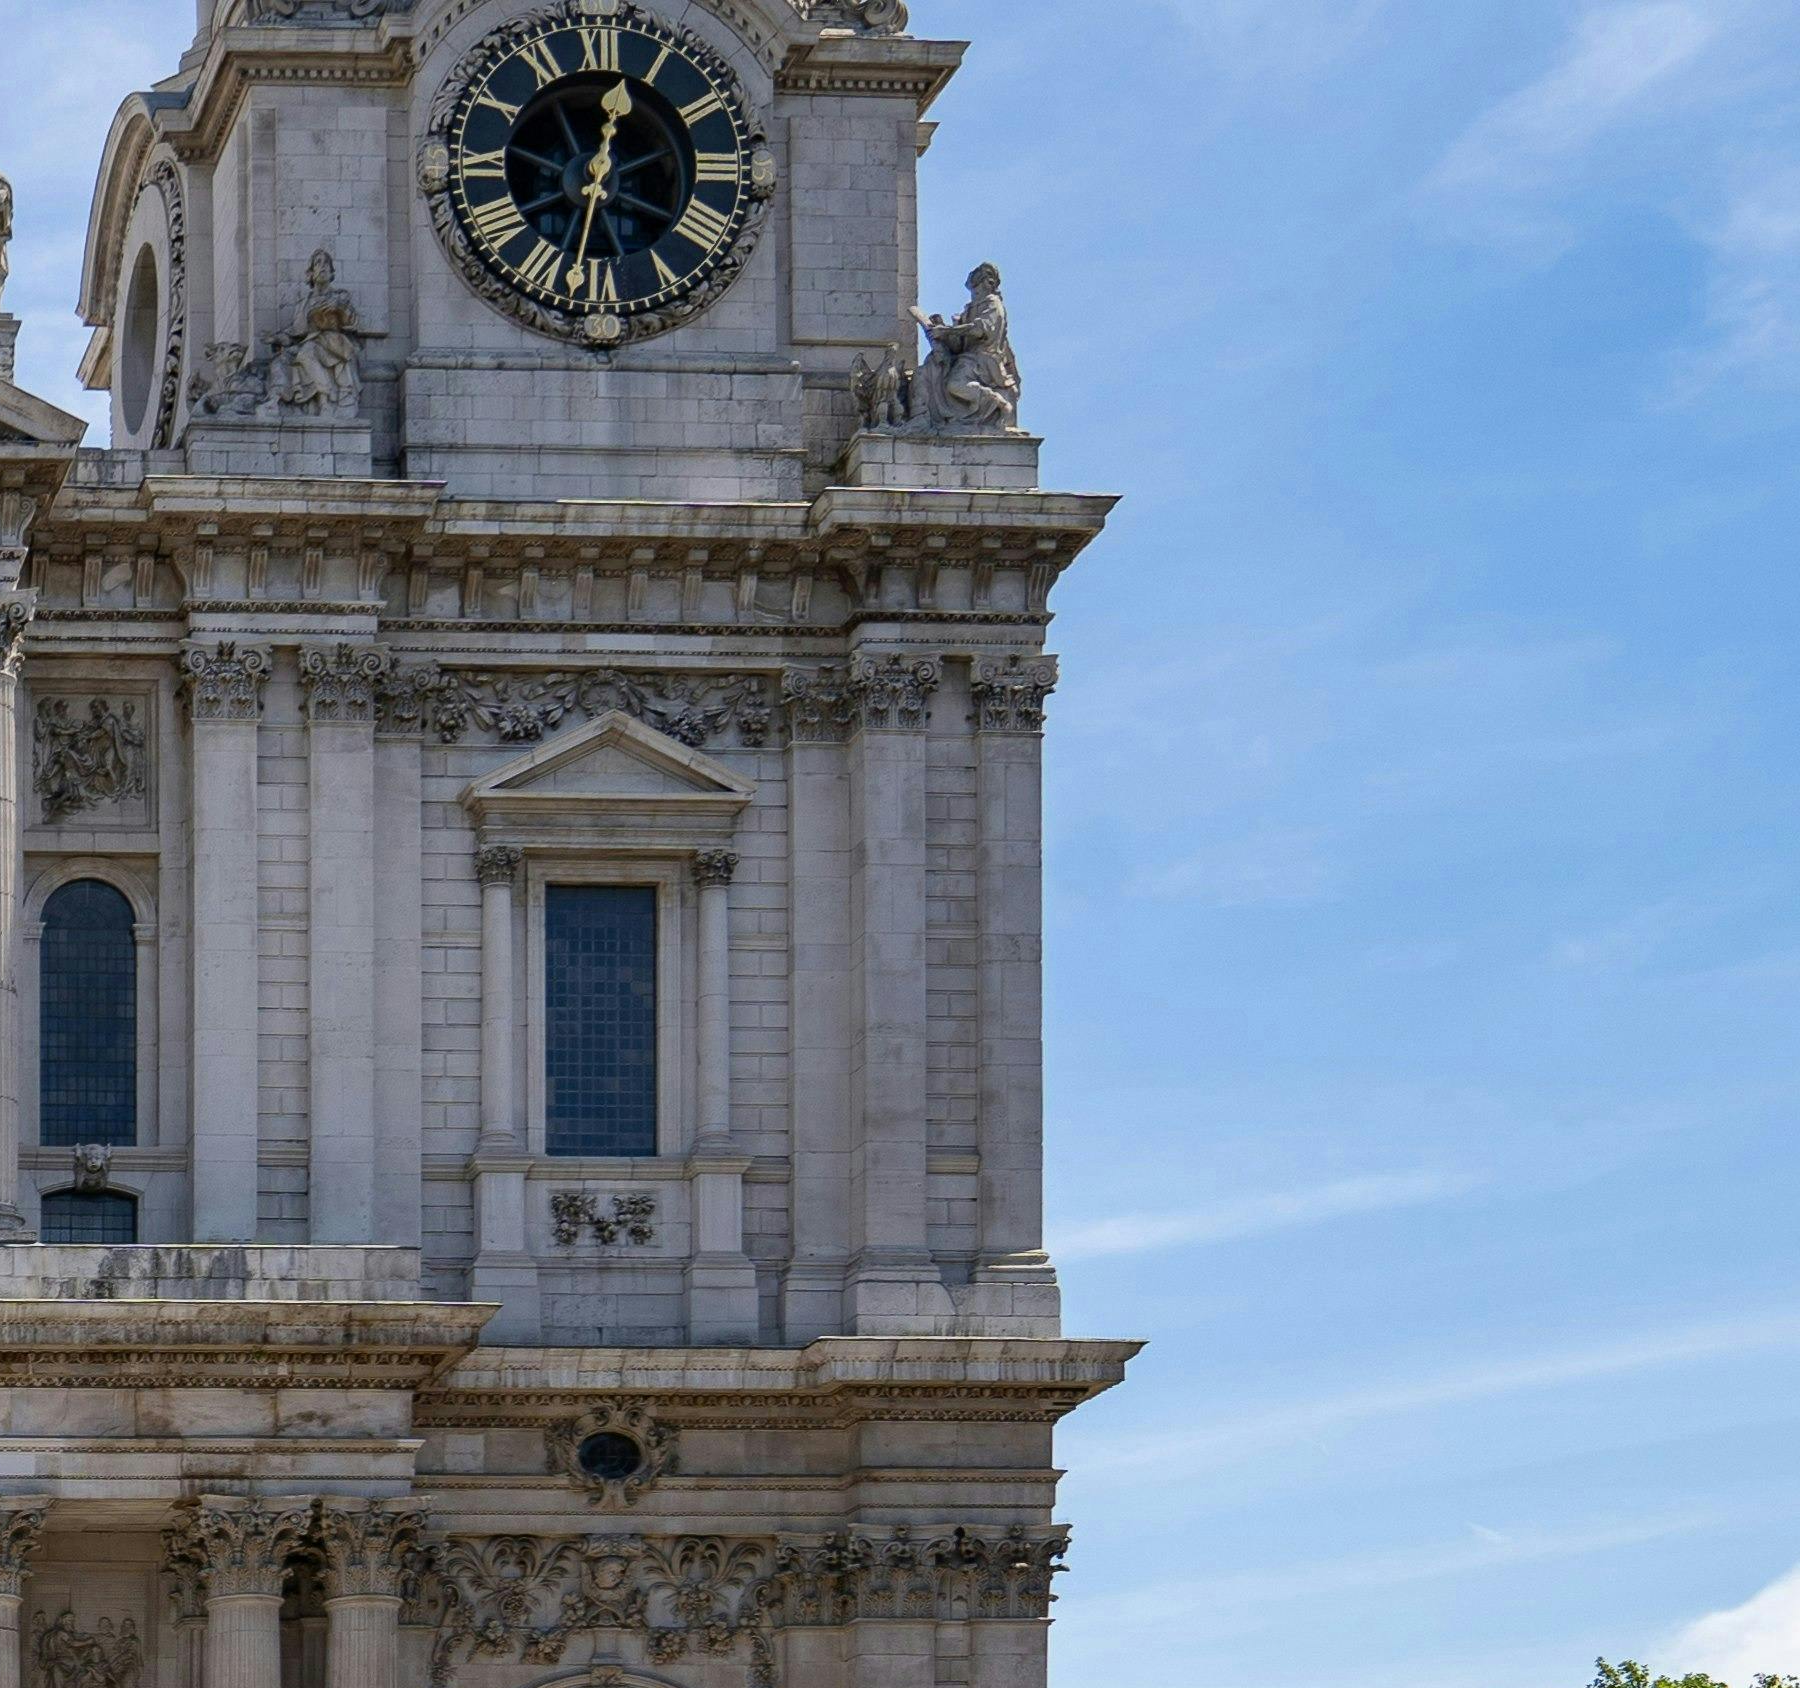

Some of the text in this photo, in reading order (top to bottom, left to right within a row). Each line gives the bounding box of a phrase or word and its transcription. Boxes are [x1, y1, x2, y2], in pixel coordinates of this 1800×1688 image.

[516, 39, 567, 90] XI
[578, 28, 622, 72] XII
[474, 84, 523, 126] X
[677, 90, 730, 128] II
[462, 146, 506, 181] IX
[695, 149, 740, 183] III
